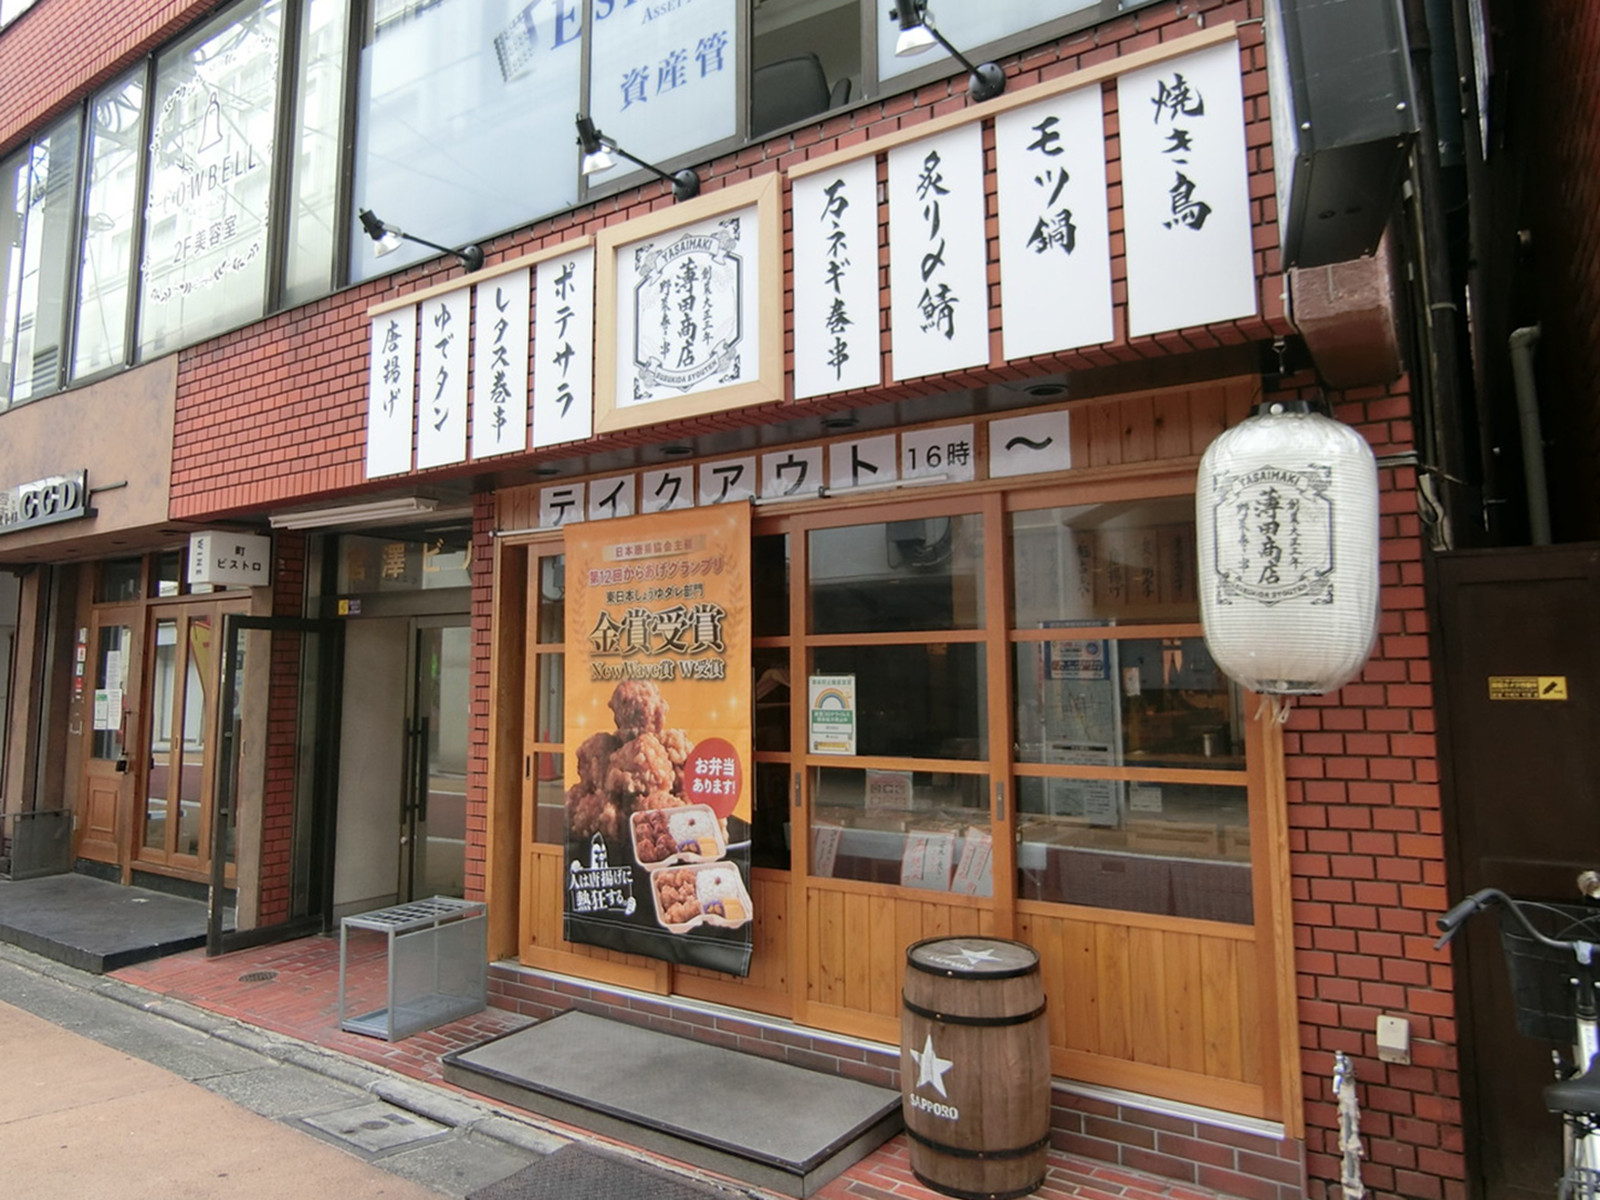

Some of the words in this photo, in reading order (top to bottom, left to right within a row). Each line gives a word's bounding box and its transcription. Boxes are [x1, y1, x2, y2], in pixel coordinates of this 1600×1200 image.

[620, 30, 728, 112] 資産管
[1026, 116, 1077, 255] モツ鍋
[1151, 73, 1212, 231] 焼き鳥
[173, 214, 237, 264] 2F美容室
[662, 239, 713, 262] YASAIMAKI
[917, 149, 959, 341] 炙り〆鯖
[552, 261, 576, 419] ポテサラ
[675, 256, 699, 369] 薄田商店
[381, 319, 403, 419] 唐揚げ
[432, 303, 454, 432] ゆでタン
[490, 287, 512, 443] レタス巻串
[1239, 470, 1300, 486] YASAIMAKI
[217, 558, 262, 571] ビストロ
[1254, 486, 1284, 584] 薄田商店
[589, 557, 724, 585] 第12回からあげグランプリ
[589, 604, 727, 657] 金賞受賞
[692, 777, 736, 795] あります!
[694, 757, 735, 776] お弁当
[568, 868, 634, 890] 人は唐揚げに
[909, 1093, 959, 1120] SAPPORO
